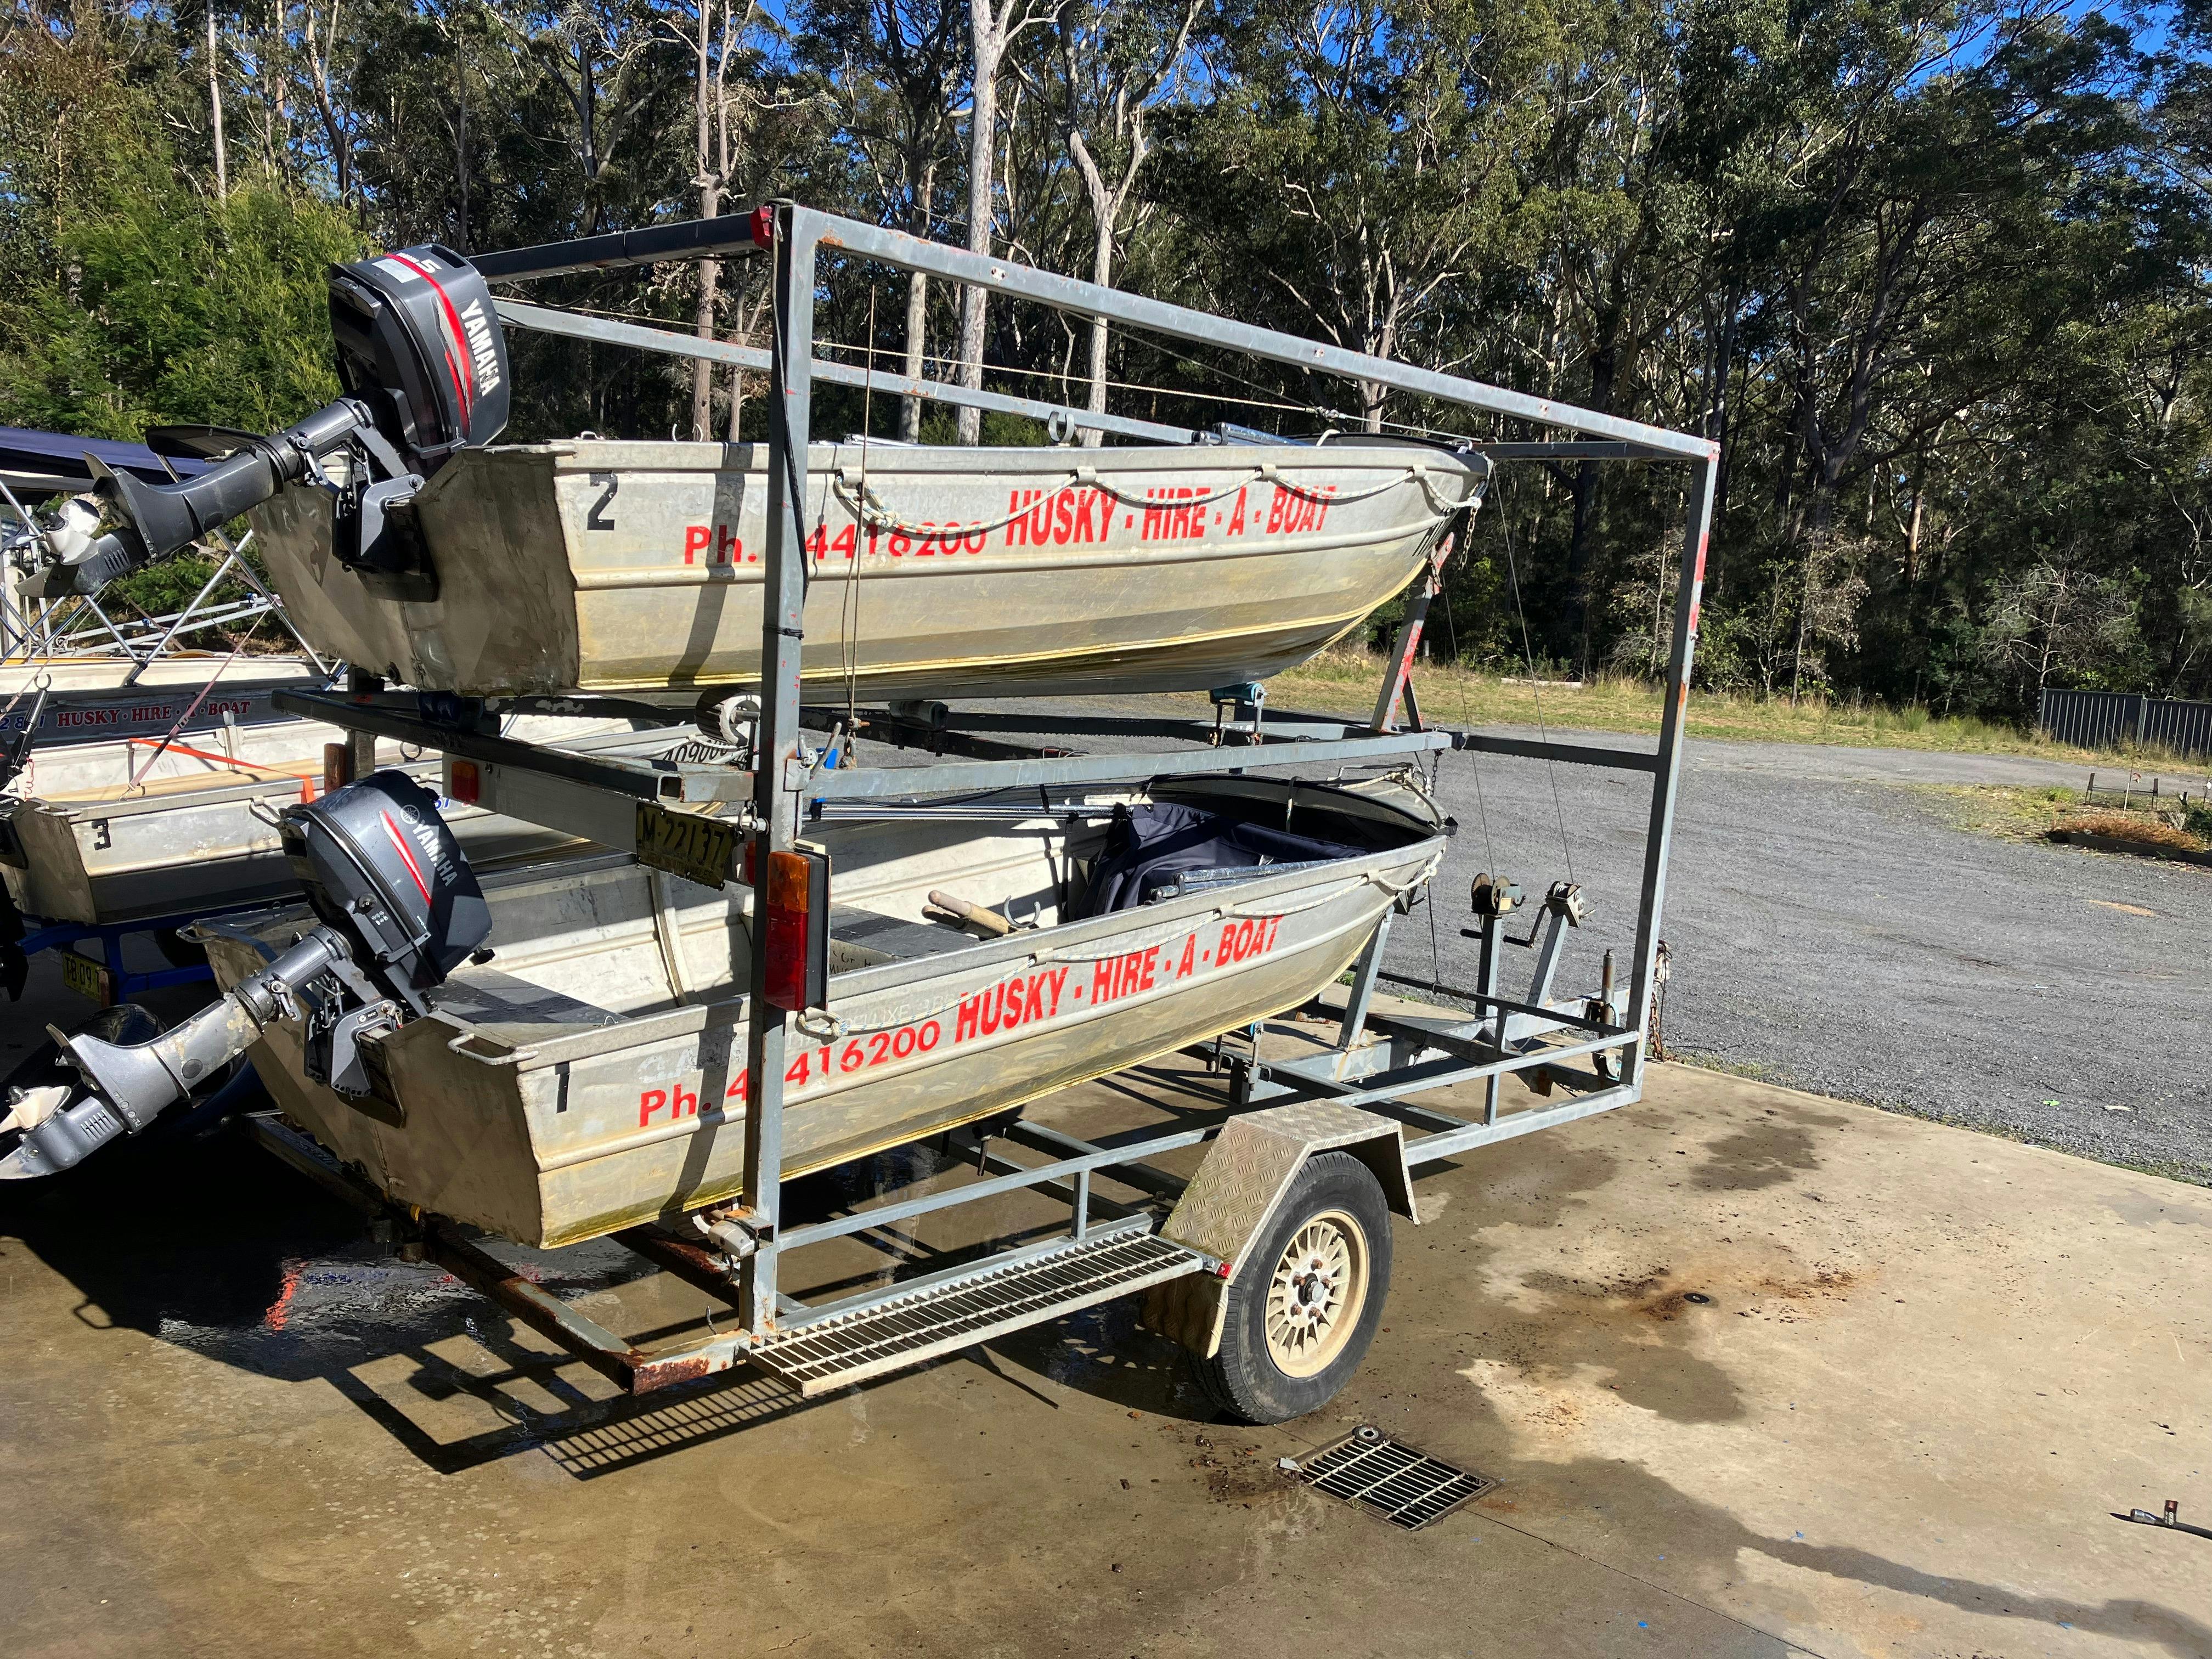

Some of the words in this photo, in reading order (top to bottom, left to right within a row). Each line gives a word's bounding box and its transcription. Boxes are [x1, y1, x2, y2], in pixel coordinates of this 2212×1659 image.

[460, 298, 501, 397] YAMAHA
[587, 471, 618, 531] 2
[684, 524, 757, 565] Ph.
[805, 521, 987, 560] 4416200
[1005, 488, 1119, 546] HUSKY
[1141, 487, 1211, 541] HIRE
[1227, 487, 1247, 536] A
[1266, 485, 1337, 534] BOAT
[57, 708, 120, 728] HUSKY
[130, 706, 172, 722] HIRE
[208, 701, 251, 716] BOAT
[91, 817, 111, 851] 3
[411, 819, 458, 887] YAMAHA
[639, 1084, 712, 1127] Ph.
[955, 966, 1069, 1042] HUSKY
[1091, 945, 1160, 1005] HIRE
[1176, 933, 1196, 980] A
[1215, 913, 1284, 968] BOAT
[554, 1060, 571, 1114] 1
